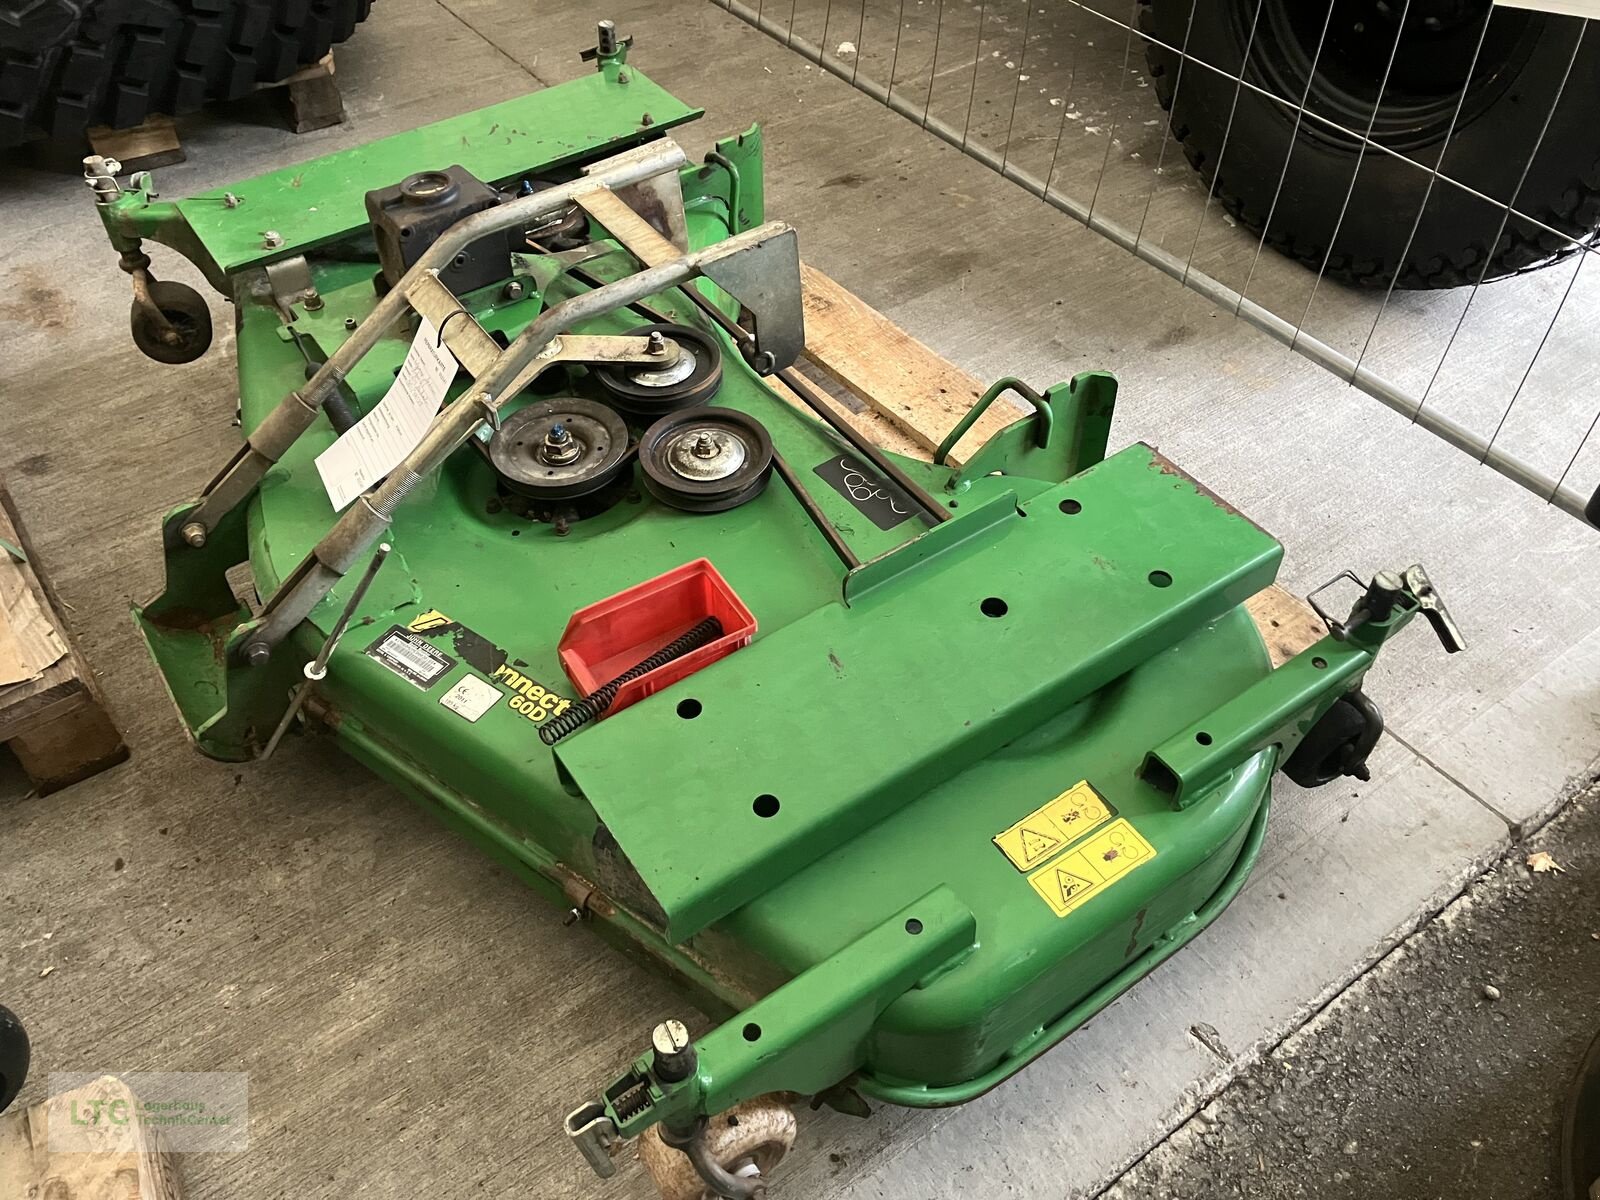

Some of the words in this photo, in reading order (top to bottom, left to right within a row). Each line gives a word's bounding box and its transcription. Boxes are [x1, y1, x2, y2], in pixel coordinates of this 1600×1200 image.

[405, 634, 424, 647] JOHN
[421, 643, 443, 658] DEERE
[508, 694, 548, 722] 60D
